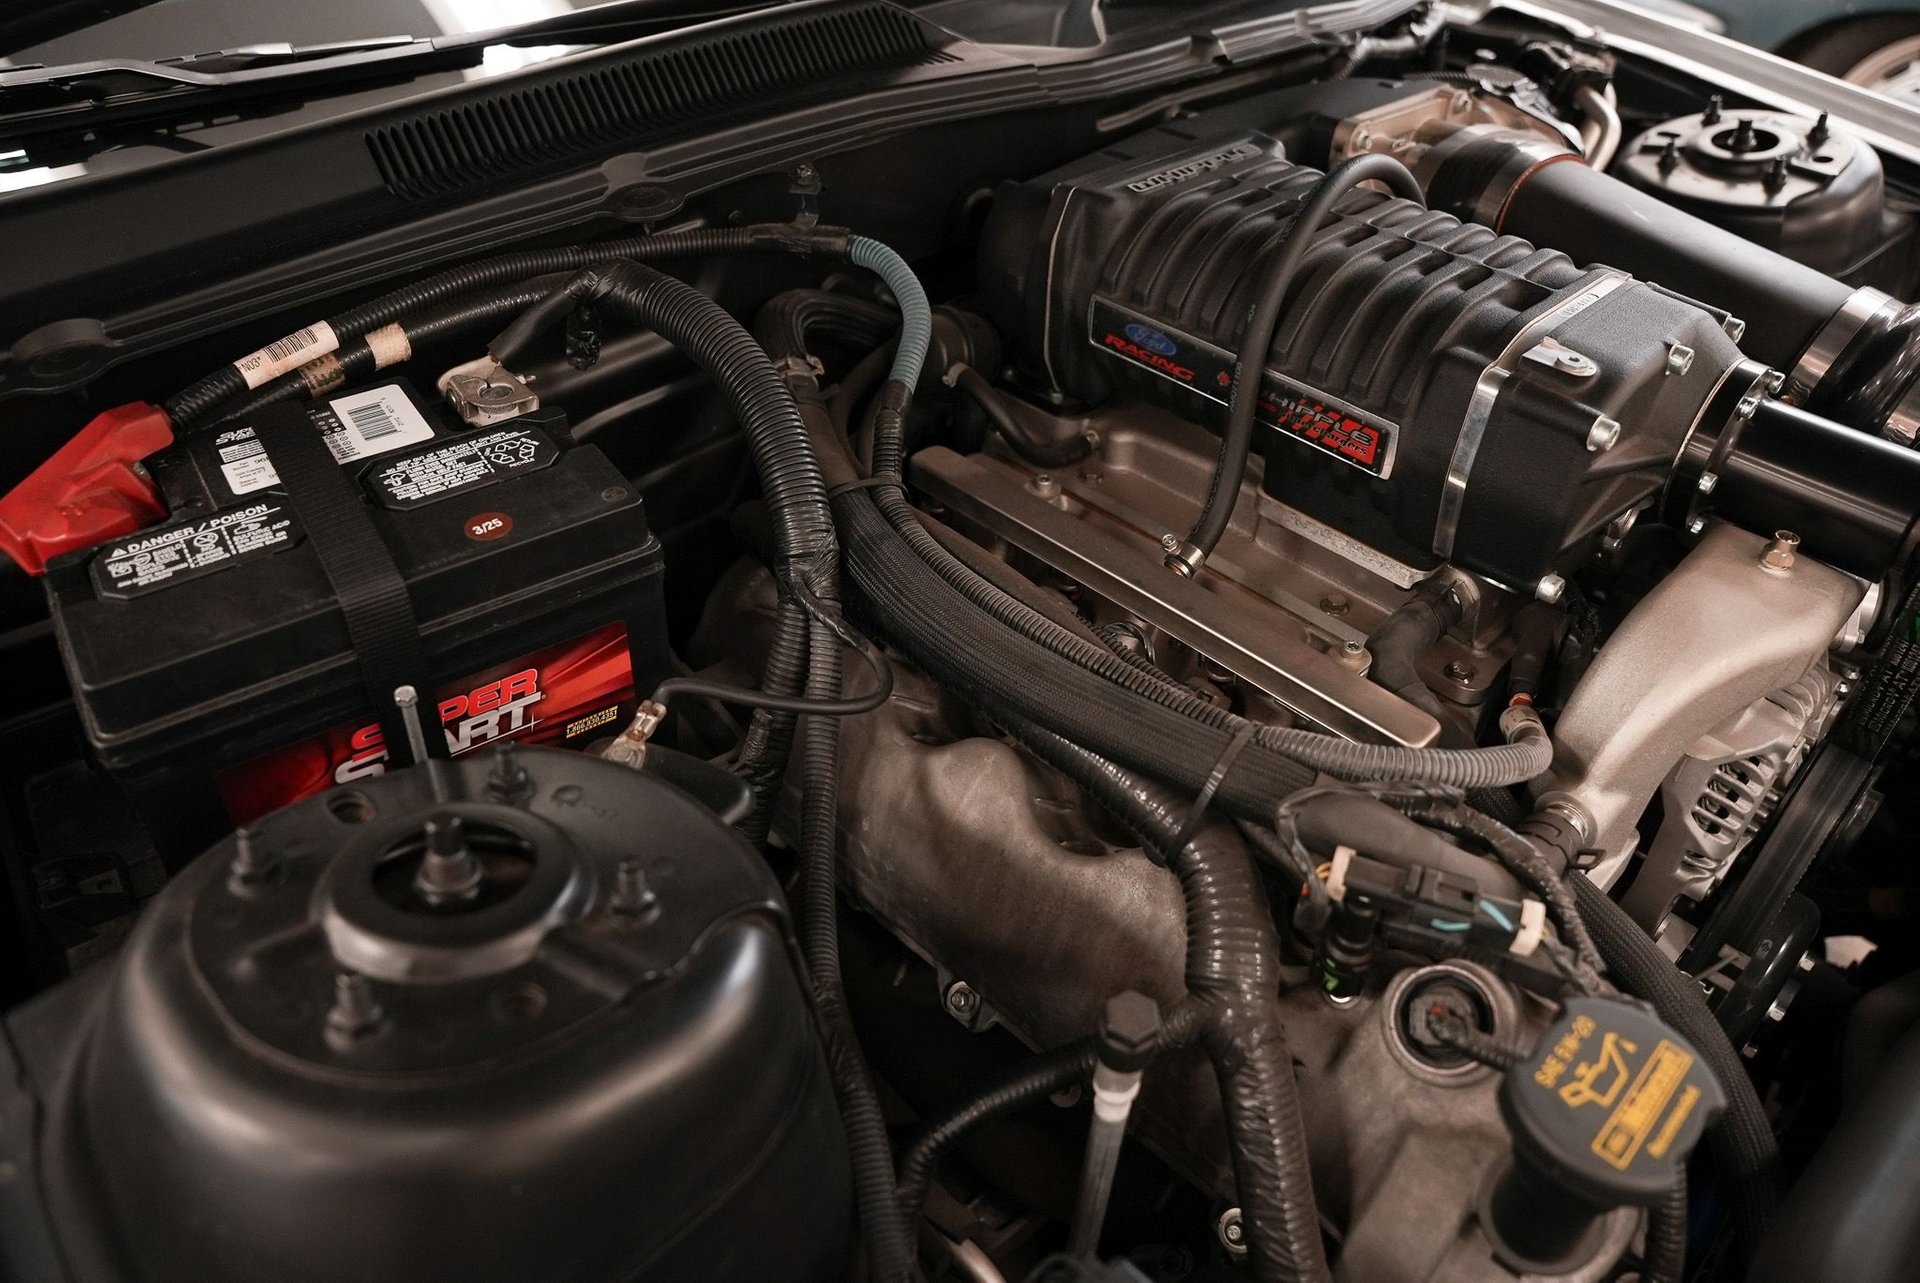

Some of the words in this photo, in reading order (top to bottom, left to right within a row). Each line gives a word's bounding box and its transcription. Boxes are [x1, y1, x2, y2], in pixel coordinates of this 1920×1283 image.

[1104, 332, 1195, 382] RACING
[1263, 392, 1374, 446] HIPPLE
[126, 525, 195, 553] DANGER
[209, 503, 268, 527] POISON
[472, 518, 503, 535] 3/25
